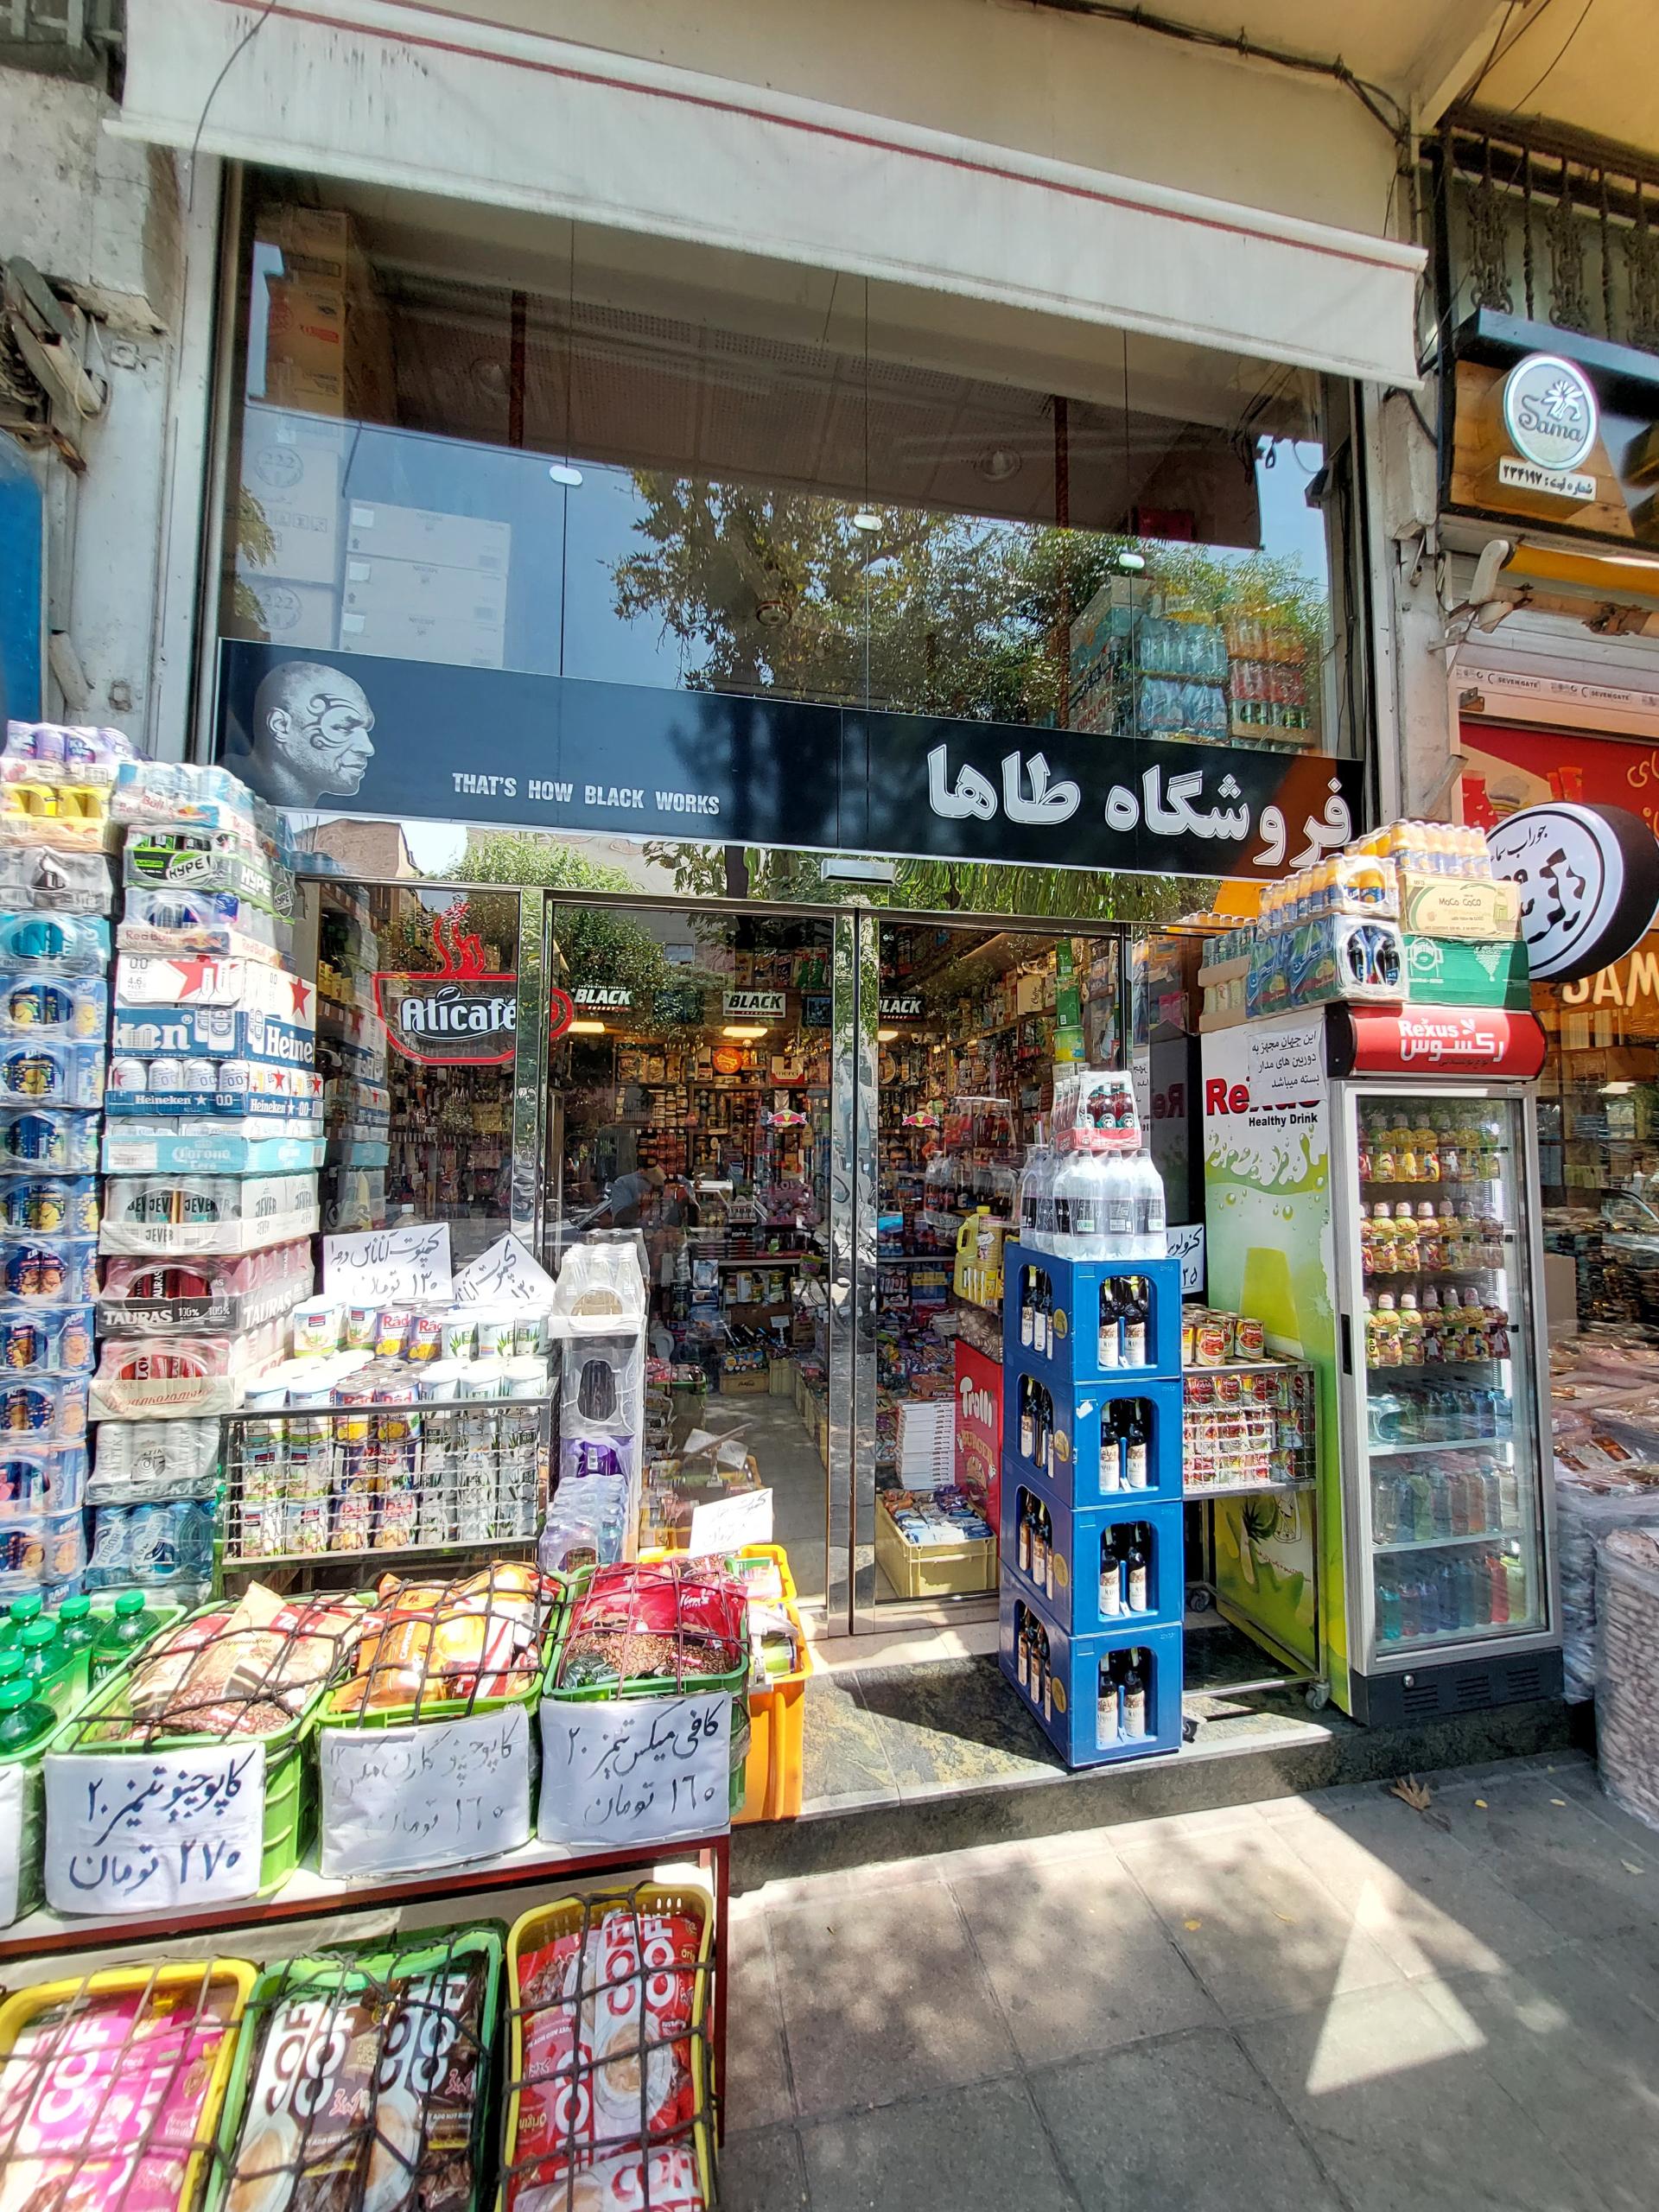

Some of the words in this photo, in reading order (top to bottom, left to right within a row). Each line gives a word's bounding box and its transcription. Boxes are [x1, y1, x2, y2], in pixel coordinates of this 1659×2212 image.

[927, 743, 1081, 825] طاها
[452, 772, 517, 798] THAT'S
[528, 779, 573, 803] HOW
[584, 785, 645, 809] BLACK
[655, 791, 720, 816] WORKS
[1104, 762, 1353, 868] فروشگاه
[240, 865, 272, 898] HYPE
[574, 988, 632, 1006] BLACK
[728, 994, 782, 1009] BLACK
[1397, 1018, 1459, 1038] Rexus
[265, 1026, 315, 1064] Heine
[1304, 1031, 1316, 1045] این
[1252, 1044, 1259, 1054] به
[1261, 1041, 1279, 1054] مجهز
[1400, 1033, 1505, 1063] رکسوس
[1258, 1060, 1274, 1073] مدار
[1276, 1057, 1290, 1070] های
[1292, 1053, 1316, 1067] دوربین
[1300, 1075, 1319, 1085] بسته
[134, 1095, 191, 1105] Heineken
[1249, 1115, 1287, 1128] Healthy
[1290, 1112, 1319, 1124] Drink
[104, 1310, 174, 1326] TAURAS
[242, 1296, 293, 1329] TAURAS
[959, 1376, 993, 1428] Trolli
[69, 1845, 159, 1896] تومان
